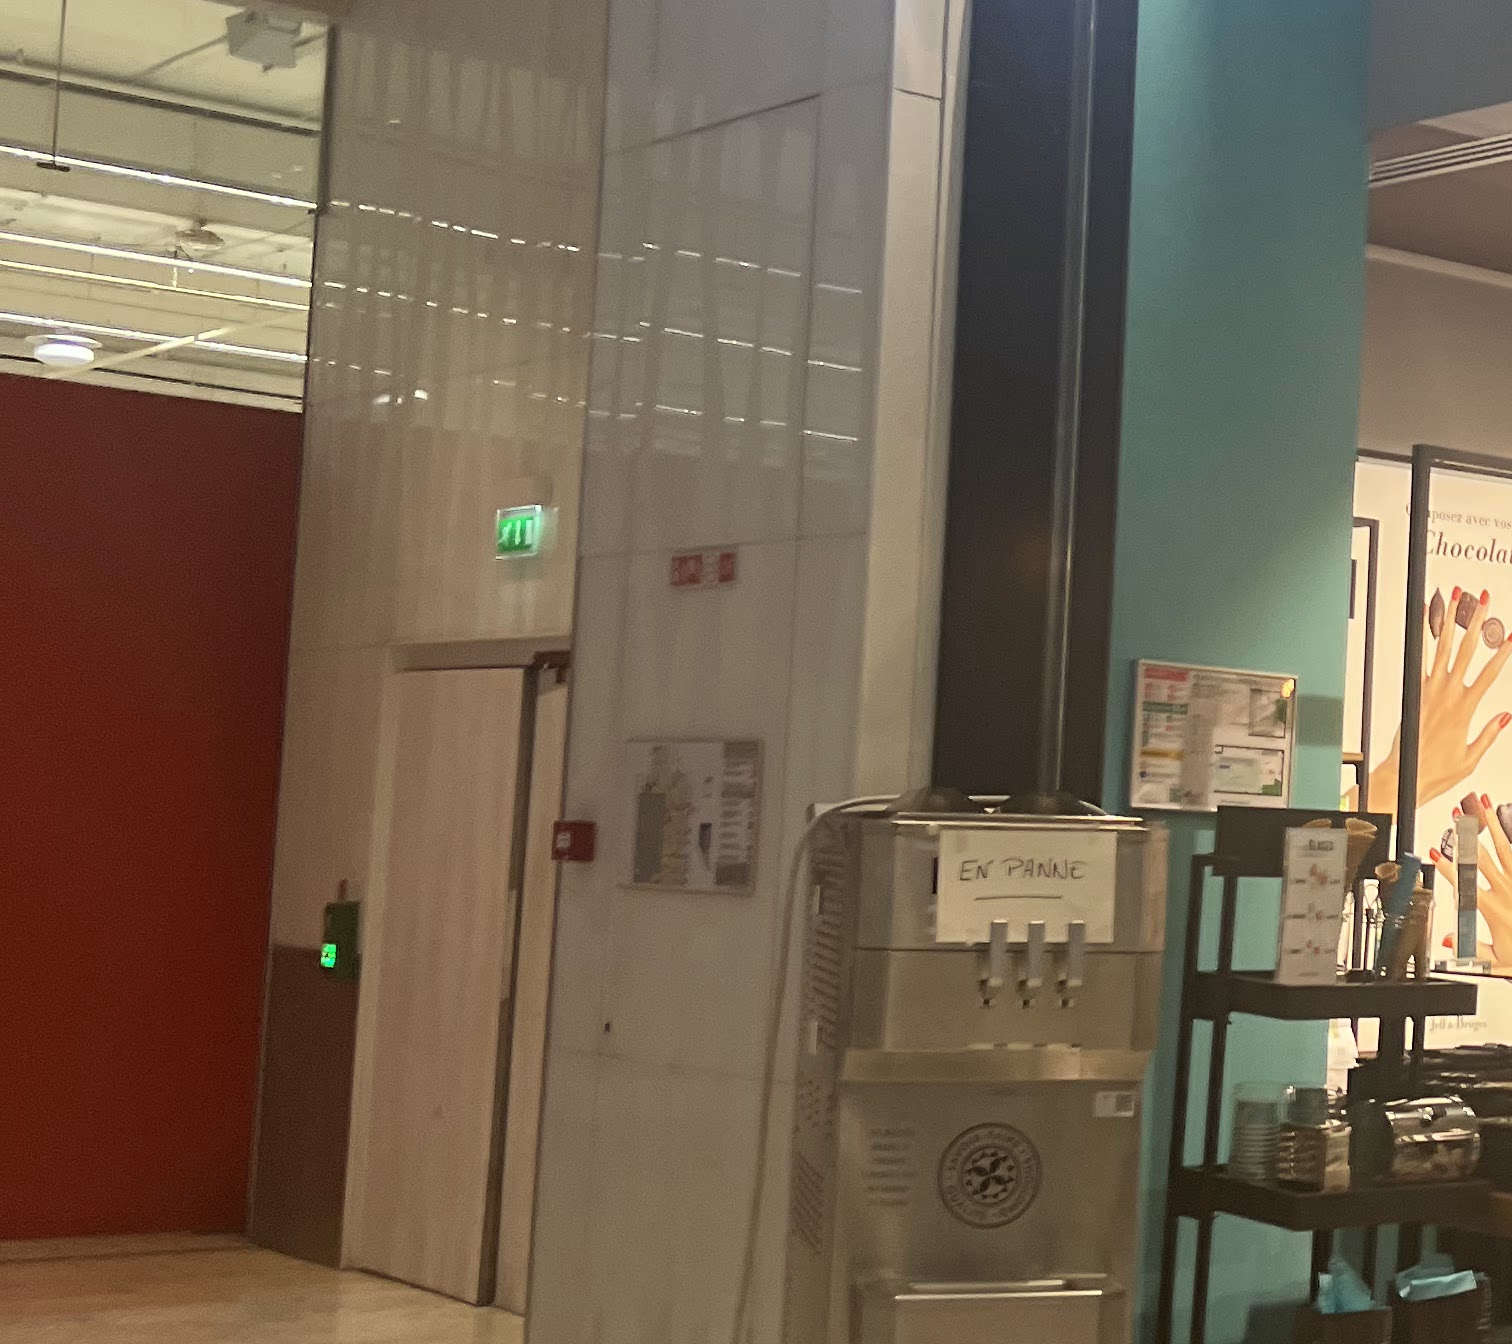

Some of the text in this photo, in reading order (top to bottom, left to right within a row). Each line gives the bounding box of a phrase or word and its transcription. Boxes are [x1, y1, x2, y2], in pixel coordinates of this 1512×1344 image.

[1465, 514, 1491, 527] avec
[1494, 518, 1512, 530] vos
[958, 858, 1088, 882] EN PANNE
